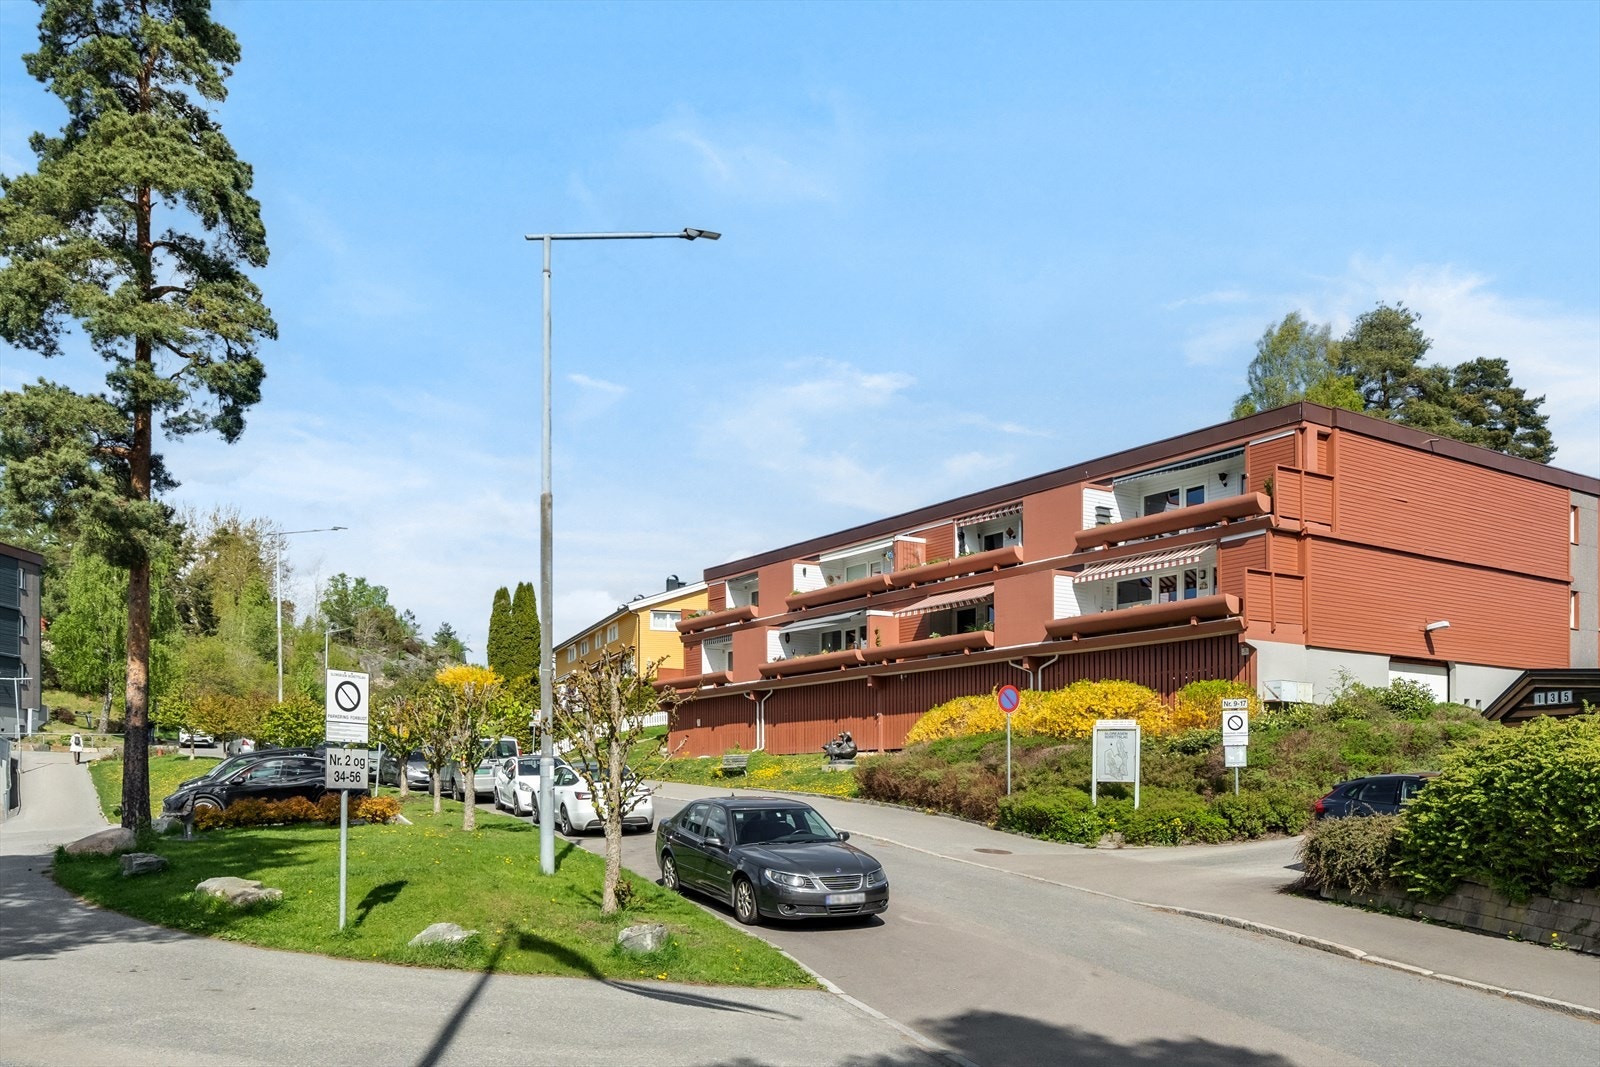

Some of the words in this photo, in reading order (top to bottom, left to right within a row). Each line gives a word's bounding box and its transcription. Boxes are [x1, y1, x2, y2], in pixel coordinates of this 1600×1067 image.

[1550, 692, 1555, 703] 3
[1564, 691, 1569, 702] 5
[329, 754, 342, 766] Nr.
[345, 754, 351, 767] 2
[353, 757, 366, 770] og
[333, 770, 361, 783] 34-56
